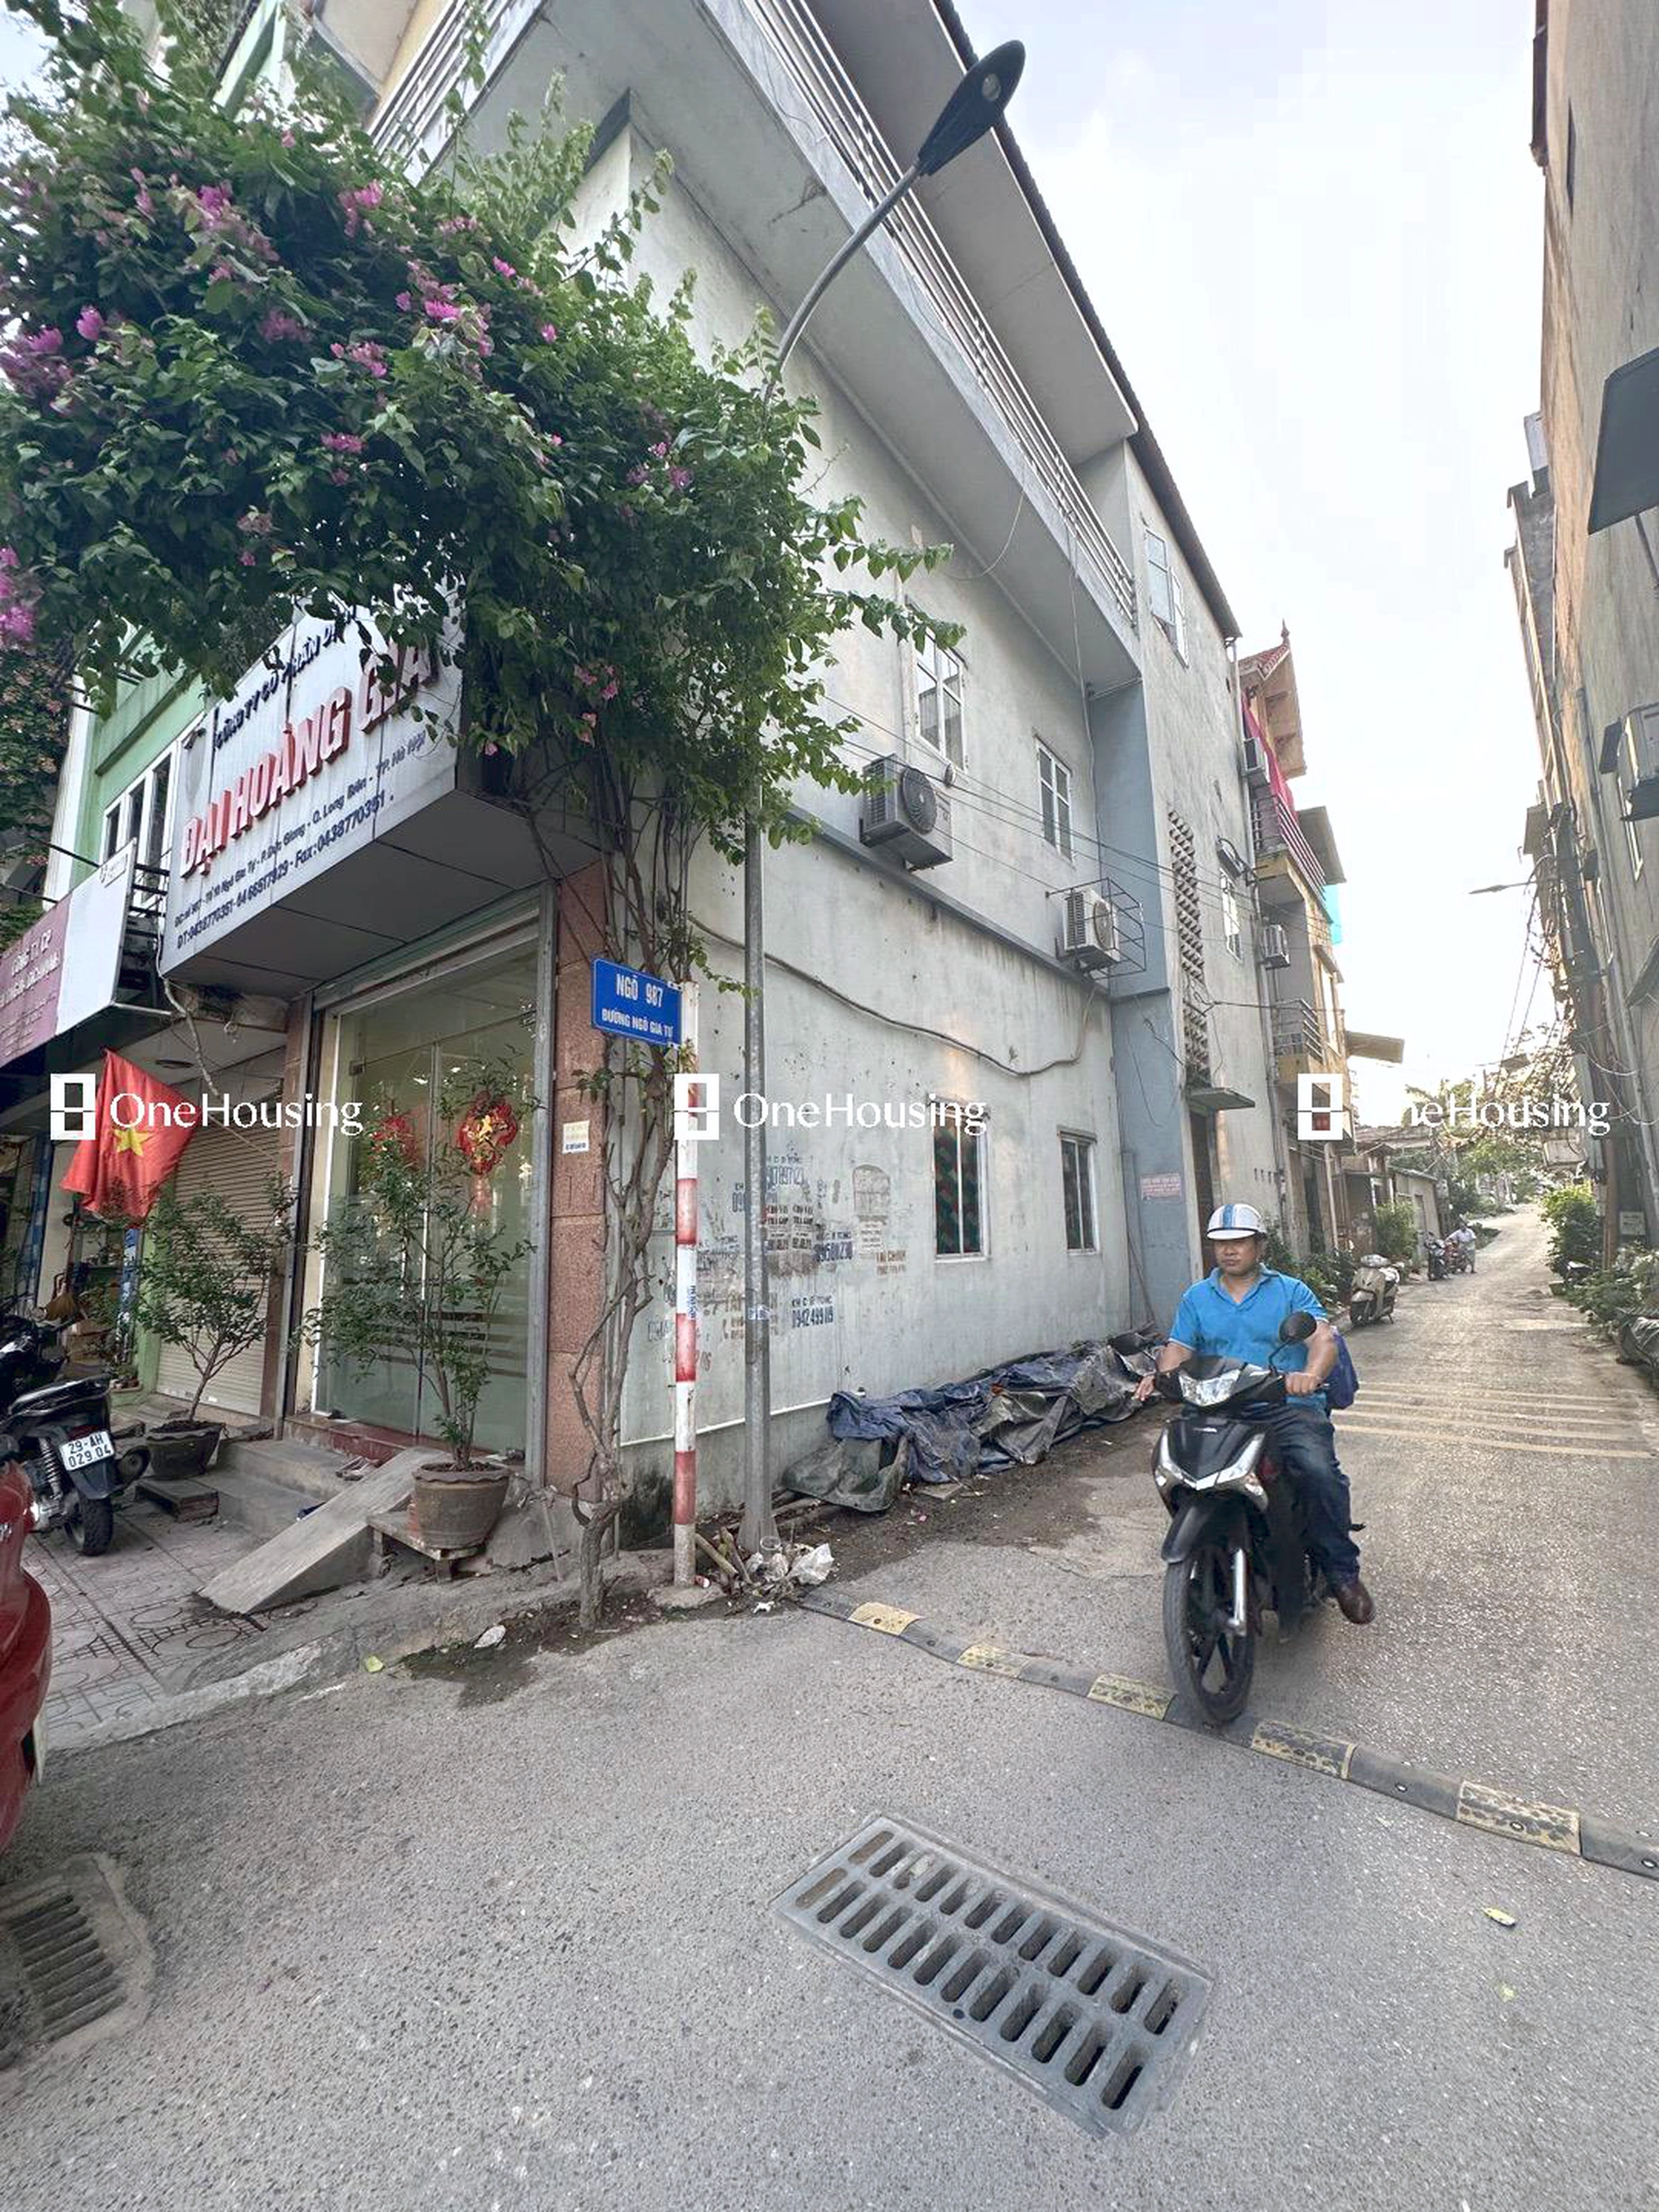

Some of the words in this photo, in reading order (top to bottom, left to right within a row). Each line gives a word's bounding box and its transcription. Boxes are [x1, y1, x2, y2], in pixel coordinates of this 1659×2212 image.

[229, 687, 352, 840] HOÀNG
[645, 983, 663, 1008] 987
[68, 1434, 104, 1455] 29-AH
